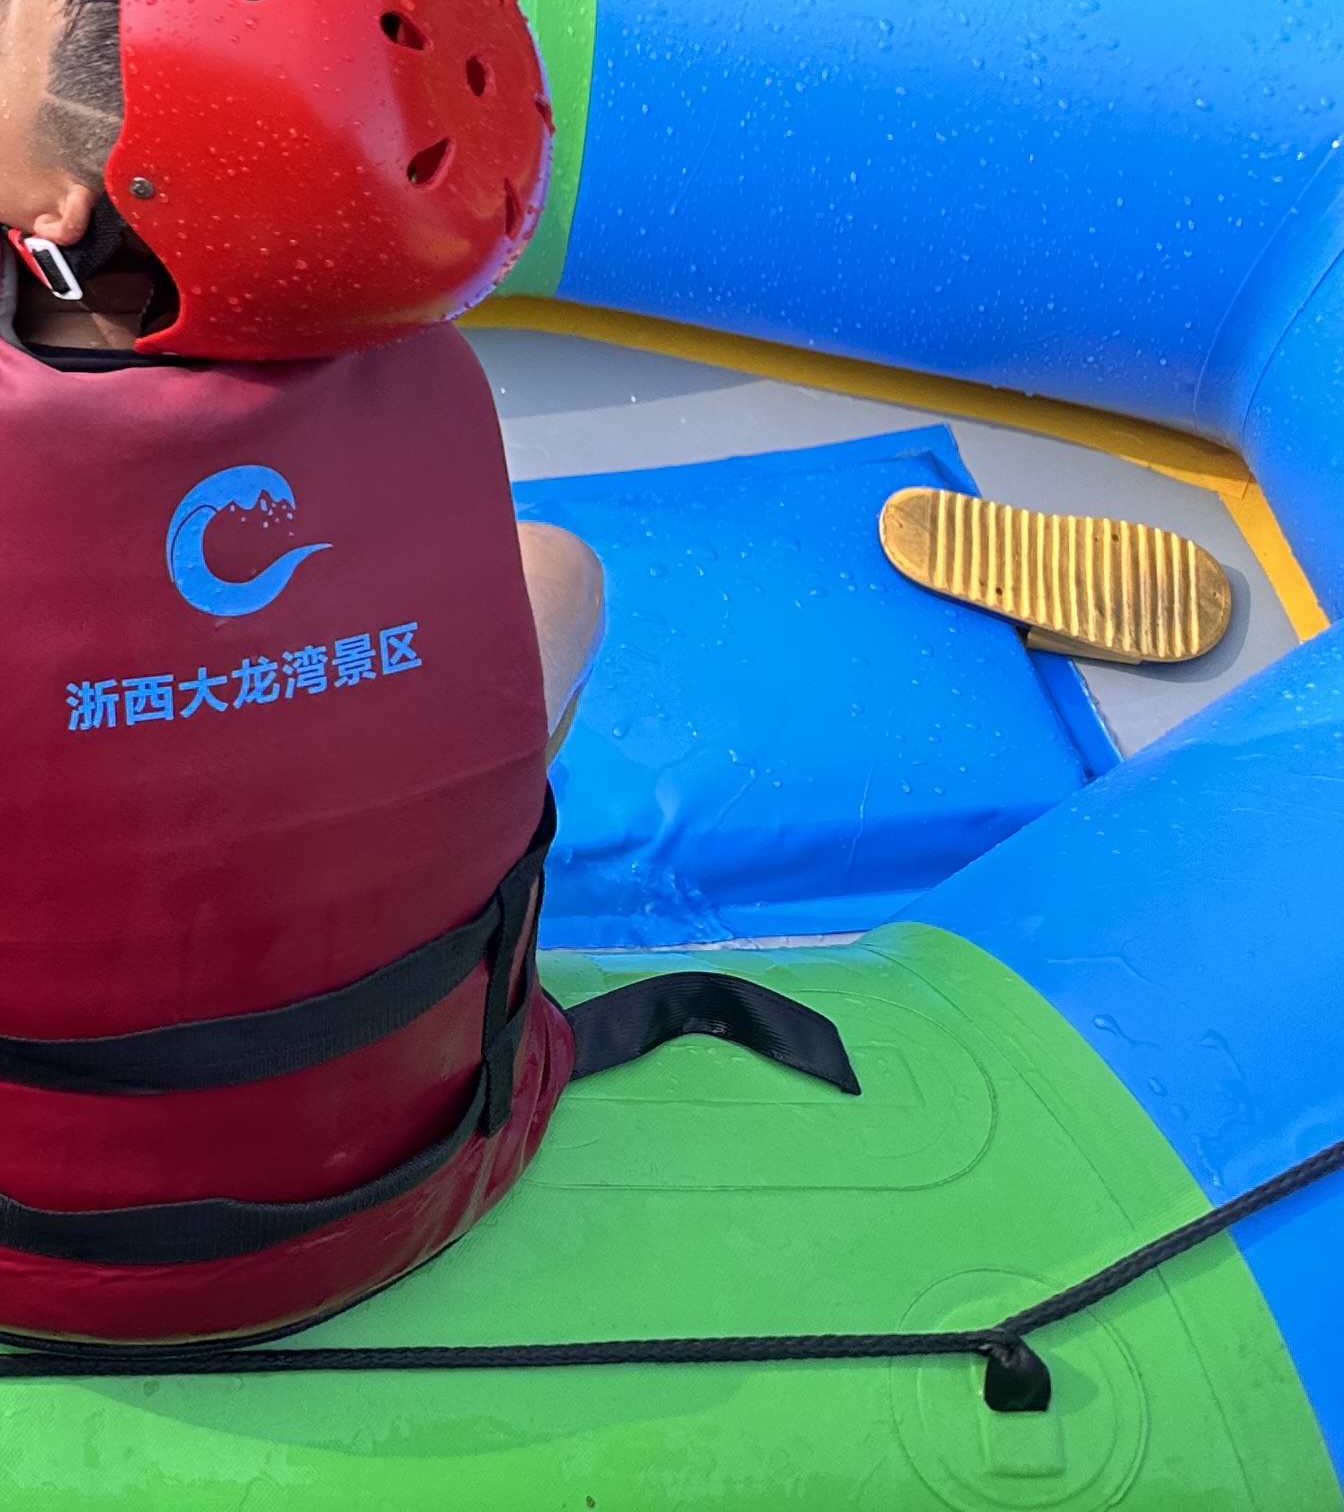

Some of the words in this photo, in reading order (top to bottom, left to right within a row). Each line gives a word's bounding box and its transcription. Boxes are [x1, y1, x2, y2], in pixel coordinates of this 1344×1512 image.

[64, 622, 422, 731] 浙西大龙湾景区
